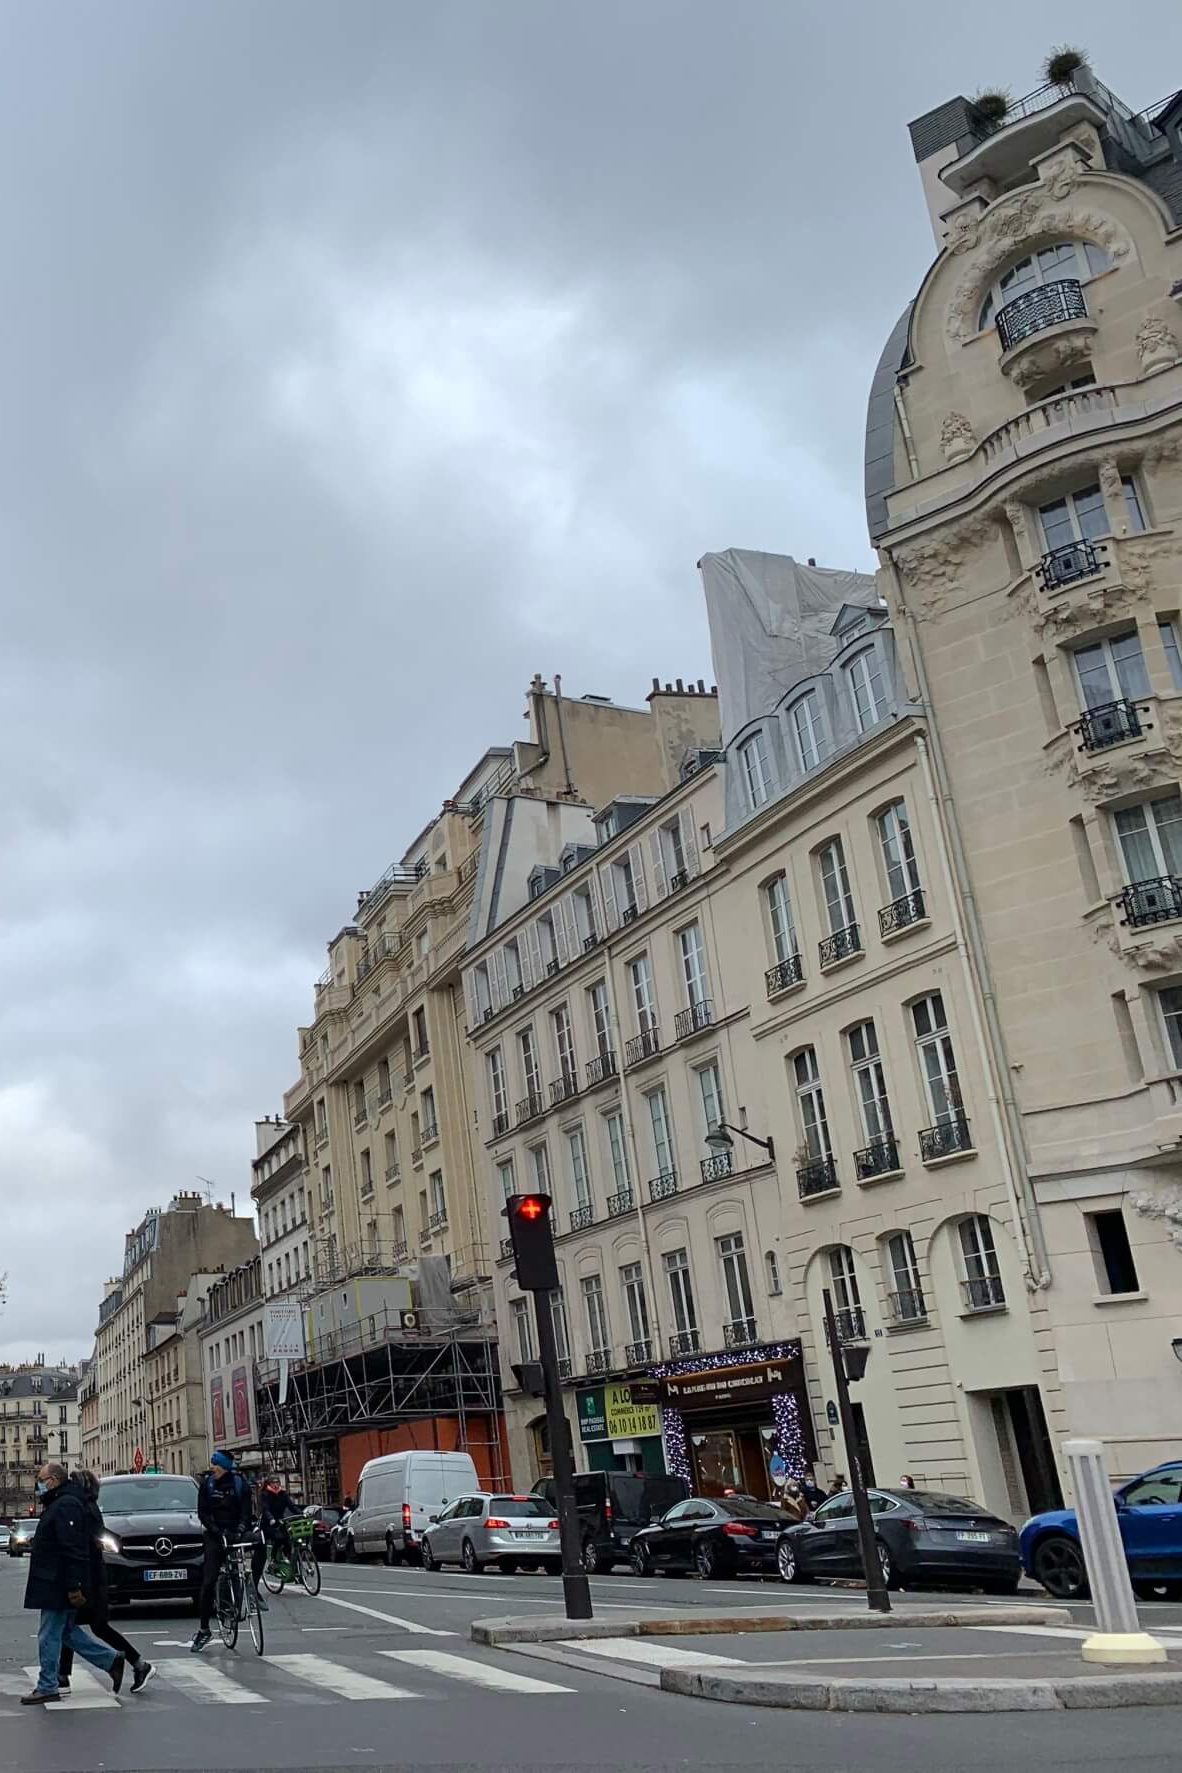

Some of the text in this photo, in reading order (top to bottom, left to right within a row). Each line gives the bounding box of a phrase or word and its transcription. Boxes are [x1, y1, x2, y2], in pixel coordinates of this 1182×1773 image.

[609, 1414, 657, 1435] 06 10 14 18 87
